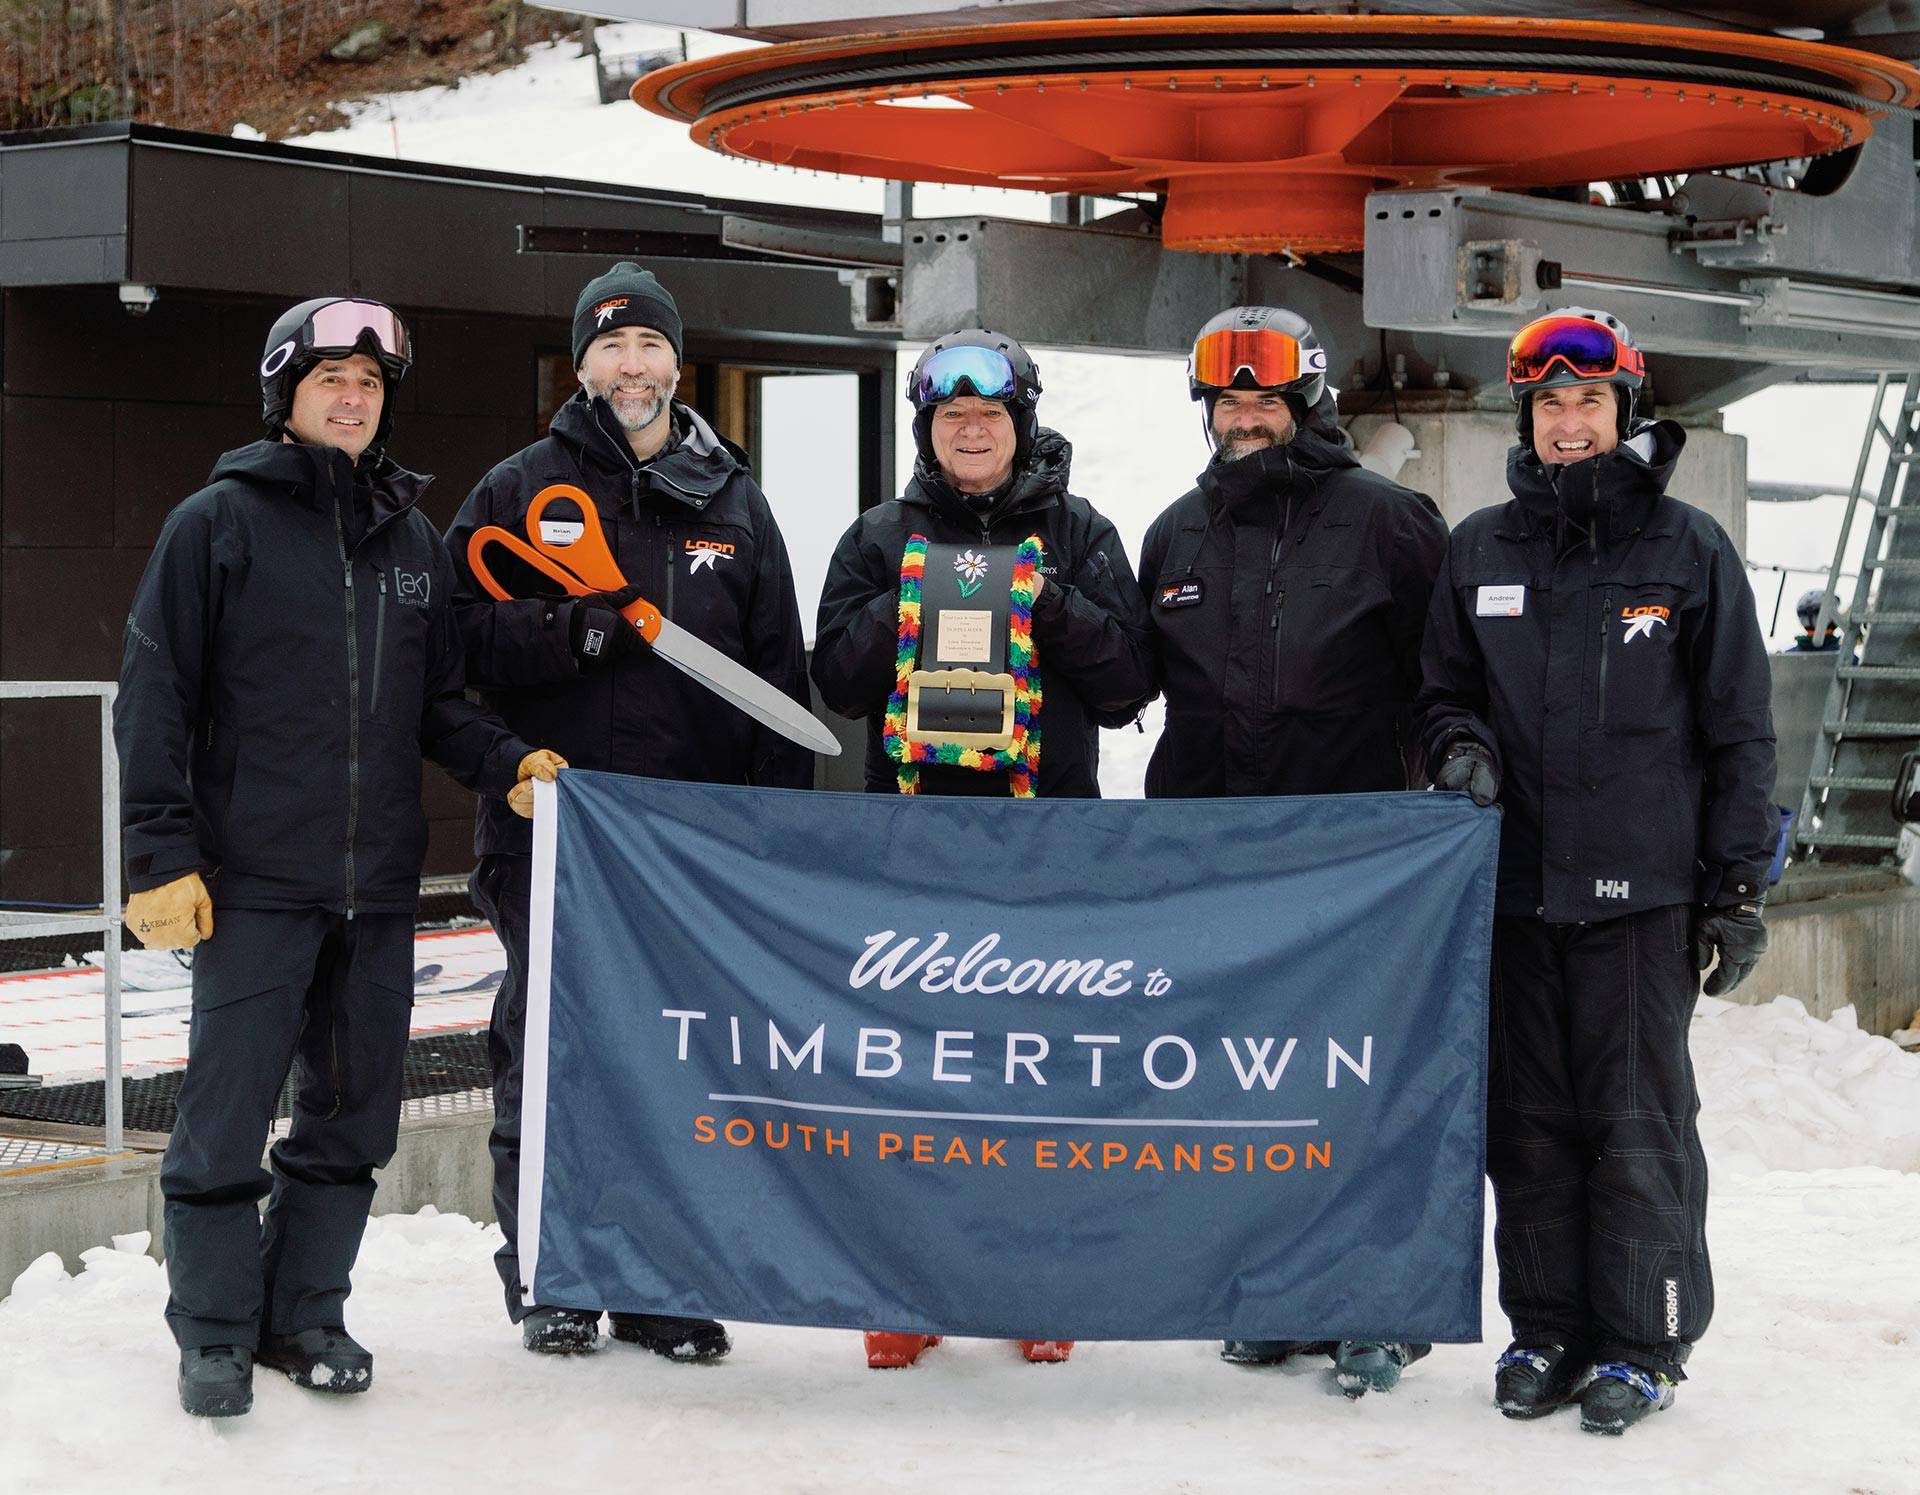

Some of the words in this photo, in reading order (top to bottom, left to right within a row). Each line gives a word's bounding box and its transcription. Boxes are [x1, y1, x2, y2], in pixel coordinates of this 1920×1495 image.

[685, 540, 735, 555] LOON
[1181, 585, 1198, 593] Alan
[1621, 605, 1670, 620] LOON
[1595, 879, 1630, 899] HH
[849, 929, 1134, 997] Welcome
[1143, 967, 1172, 997] to
[661, 1008, 1373, 1091] TIMBERTOWN
[694, 1115, 850, 1158] SOUTH
[878, 1132, 1008, 1167] PEAK
[1035, 1140, 1332, 1173] EXPANSION
[1665, 1279, 1678, 1337] KARBON
